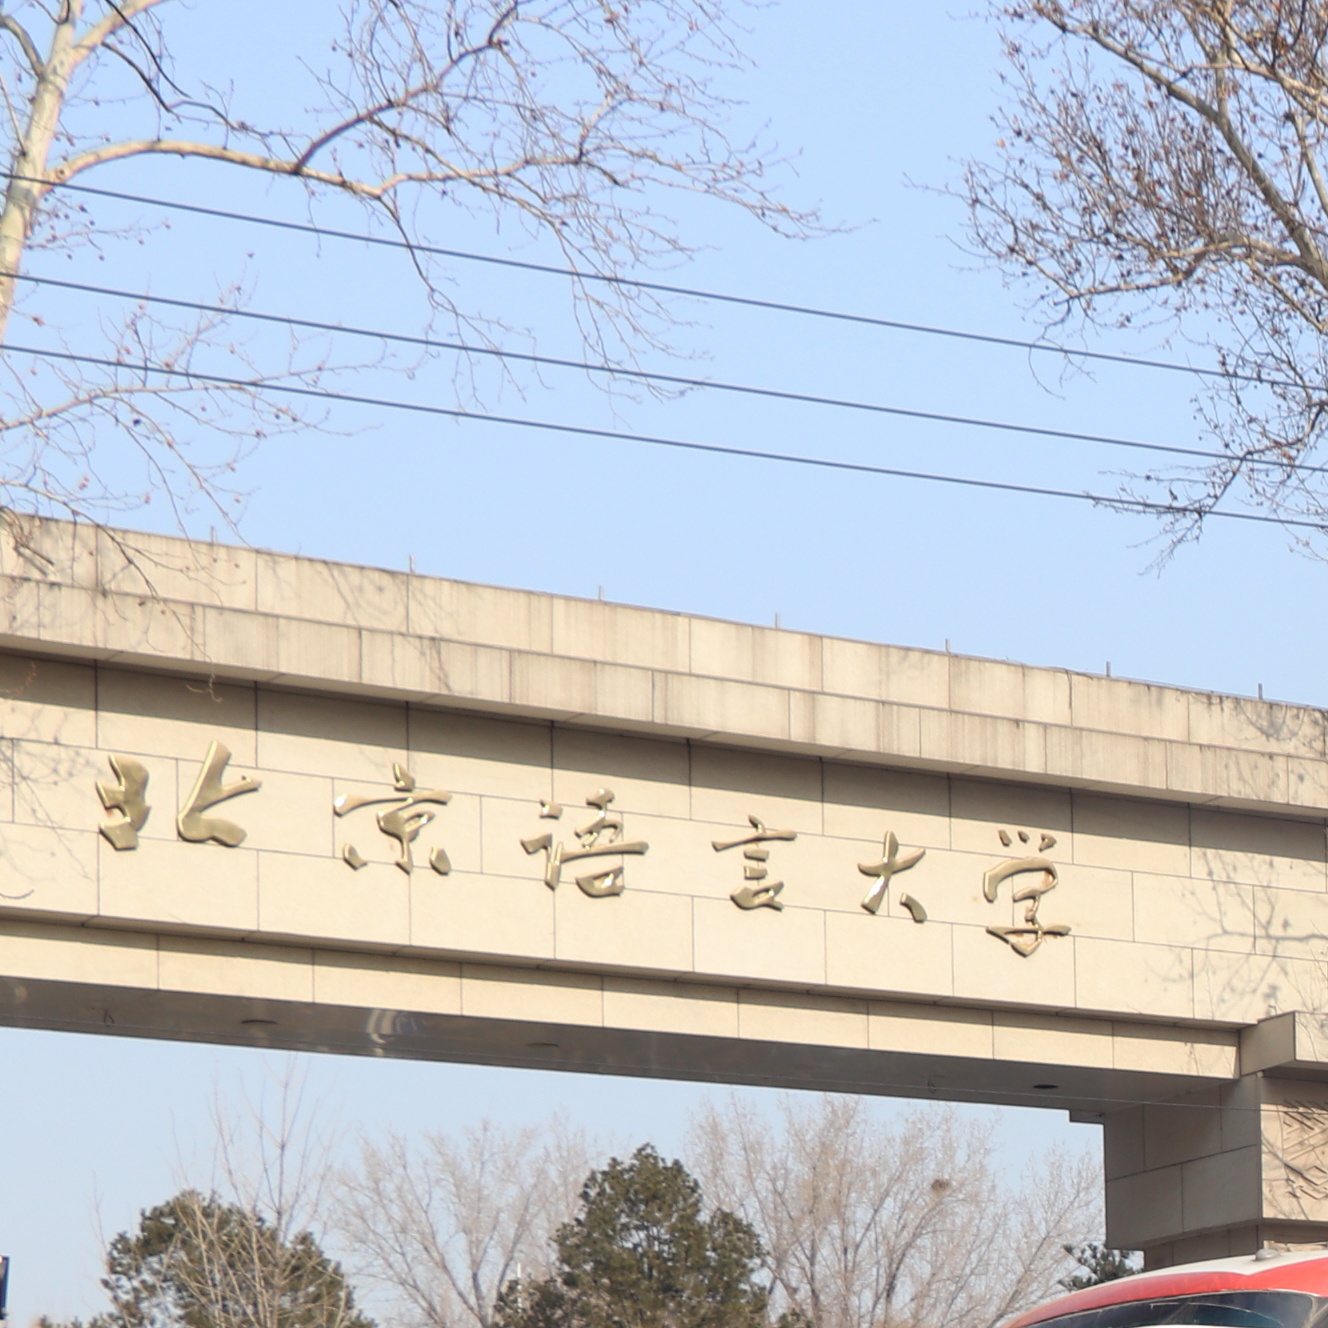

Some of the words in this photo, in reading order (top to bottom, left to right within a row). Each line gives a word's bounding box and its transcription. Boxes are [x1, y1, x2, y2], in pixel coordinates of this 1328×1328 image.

[95, 739, 1072, 958] 北京语言大学
